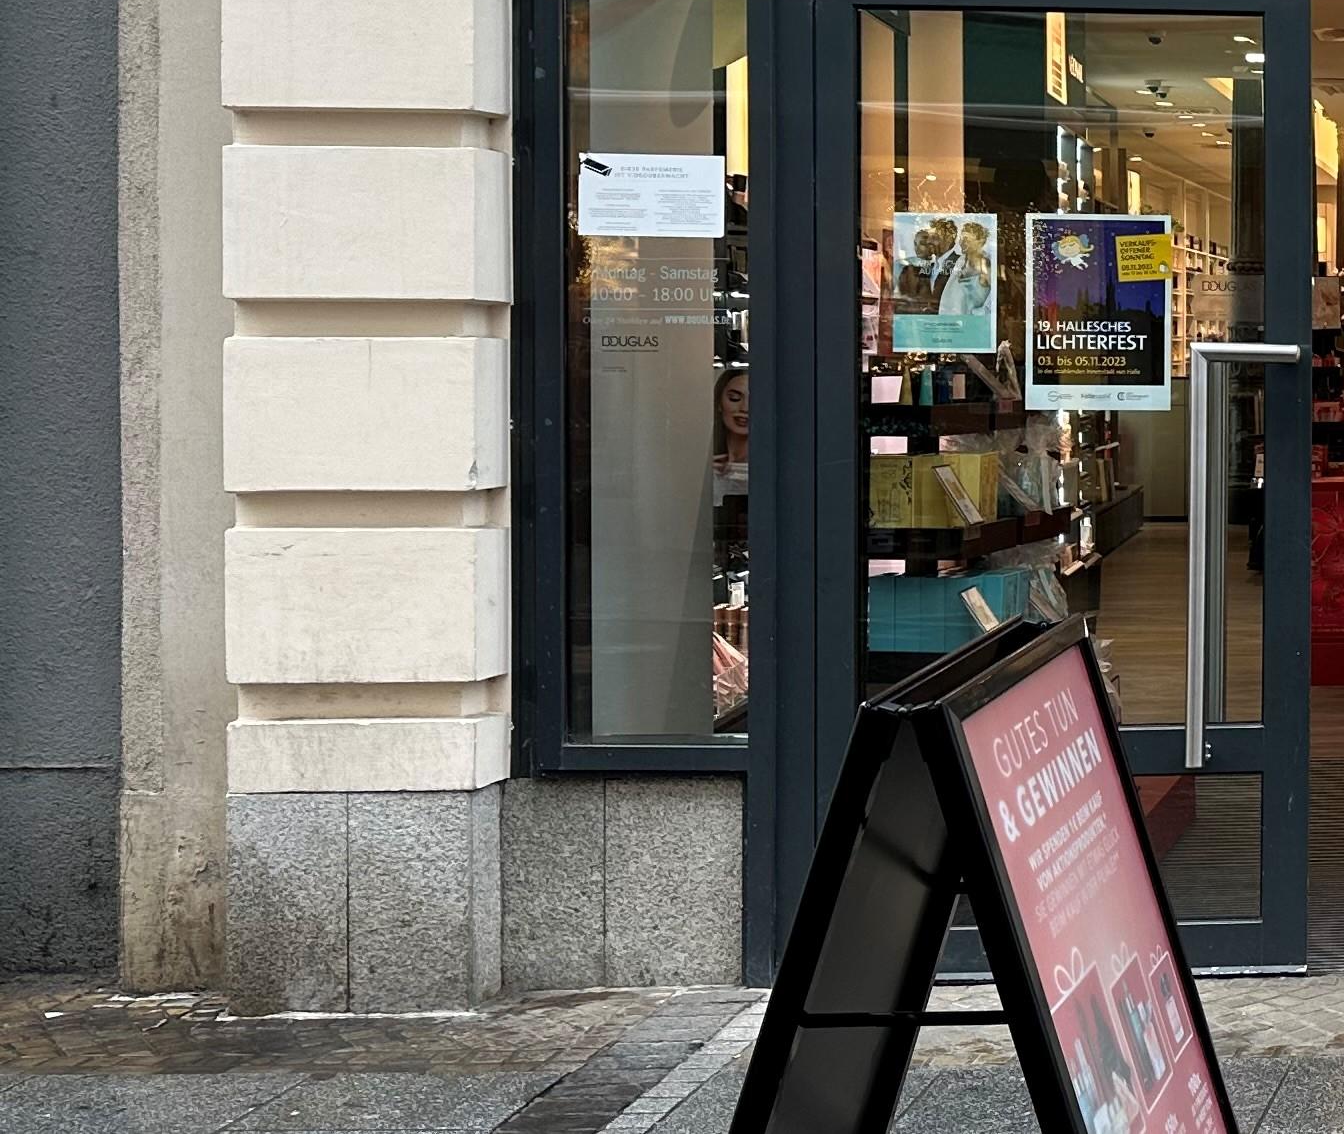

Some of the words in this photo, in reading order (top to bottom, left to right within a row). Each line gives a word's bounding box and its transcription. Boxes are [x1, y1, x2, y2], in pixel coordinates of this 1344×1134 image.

[659, 265, 719, 283] Samstag
[591, 287, 634, 302] 10:00
[652, 287, 694, 302] 18:00
[1037, 320, 1054, 332] 19.
[1056, 320, 1132, 333] HALLESCHES
[601, 335, 659, 347] DOUGLAS
[1036, 334, 1148, 351] LICHTERFEST
[1057, 355, 1073, 366] bis
[1074, 356, 1127, 367] 05.11.2023
[993, 710, 1049, 778] GUTES
[1044, 687, 1079, 738] TUN
[998, 799, 1021, 843] &
[1016, 727, 1103, 827] GEWINNEN
